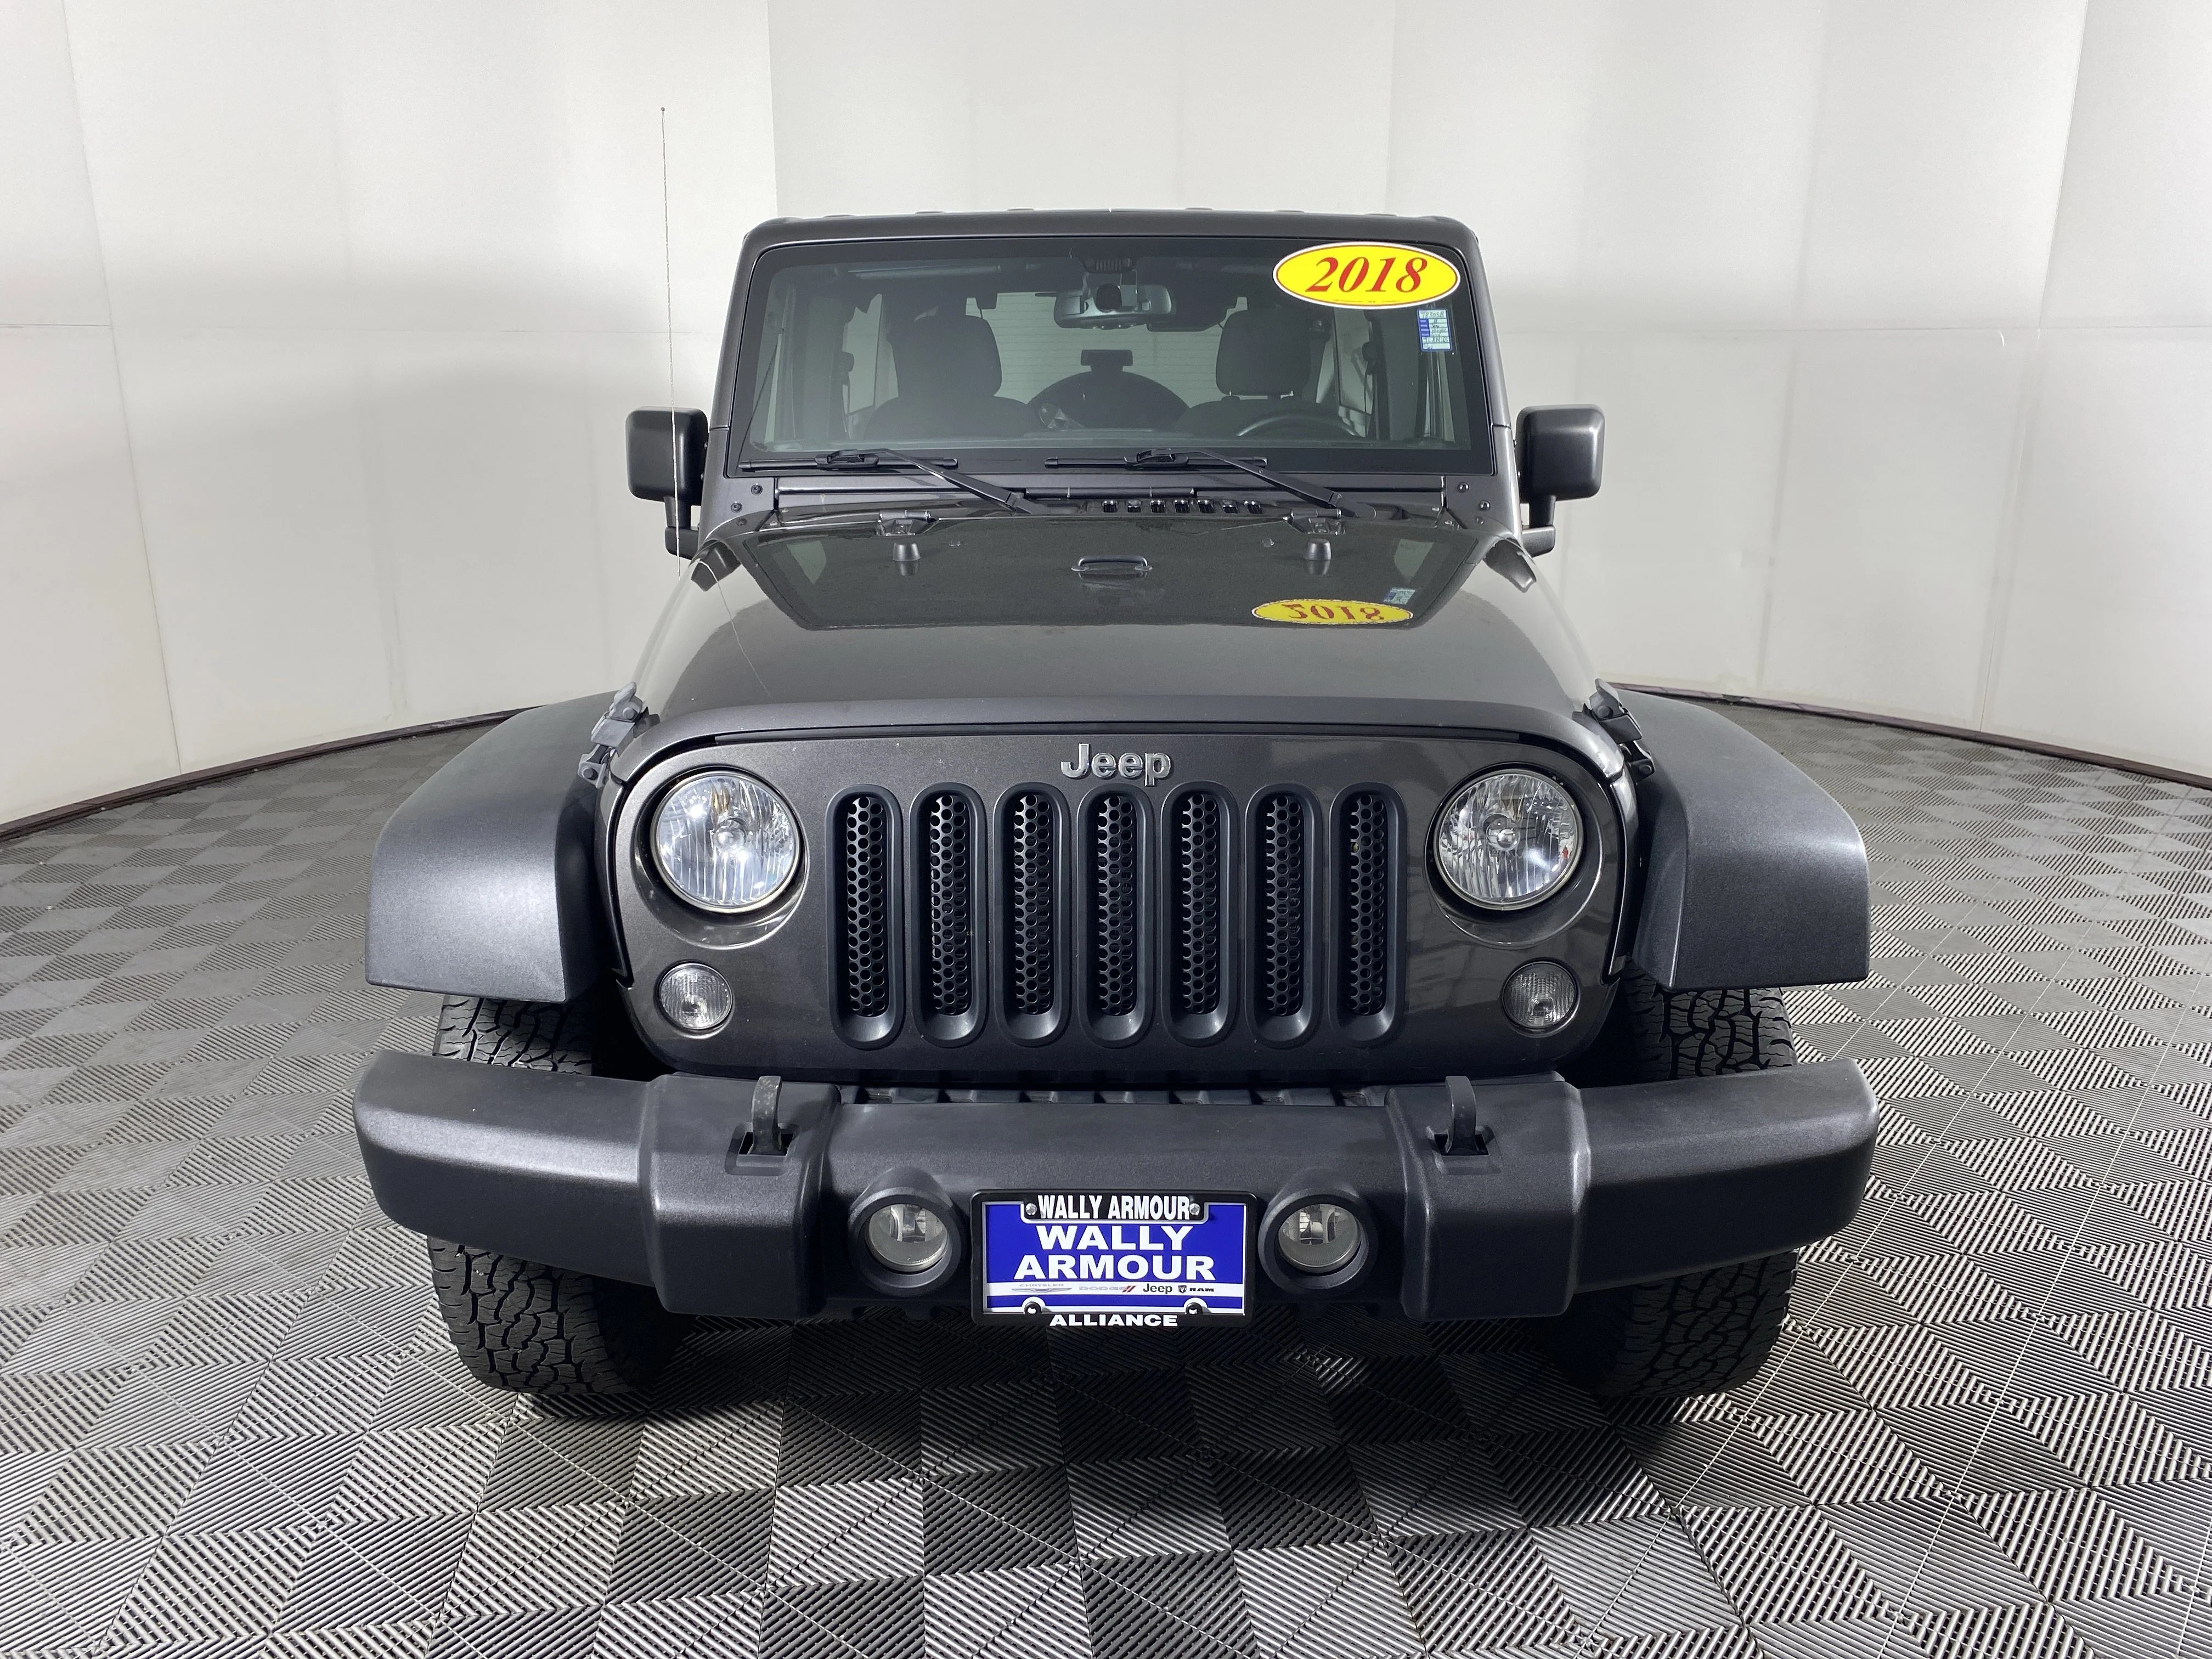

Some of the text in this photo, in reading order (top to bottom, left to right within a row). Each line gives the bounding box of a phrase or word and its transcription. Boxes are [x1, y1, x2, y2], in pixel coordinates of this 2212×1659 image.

[1305, 256, 1428, 293] 2018
[1060, 743, 1171, 787] Jeep
[1037, 1194, 1190, 1221] WALLY ARMOUR
[1036, 1225, 1193, 1251] WALLY
[1013, 1254, 1216, 1281] ARMOUR
[1143, 1283, 1173, 1294] Jeep
[1049, 1314, 1178, 1327] ALLIANCE
